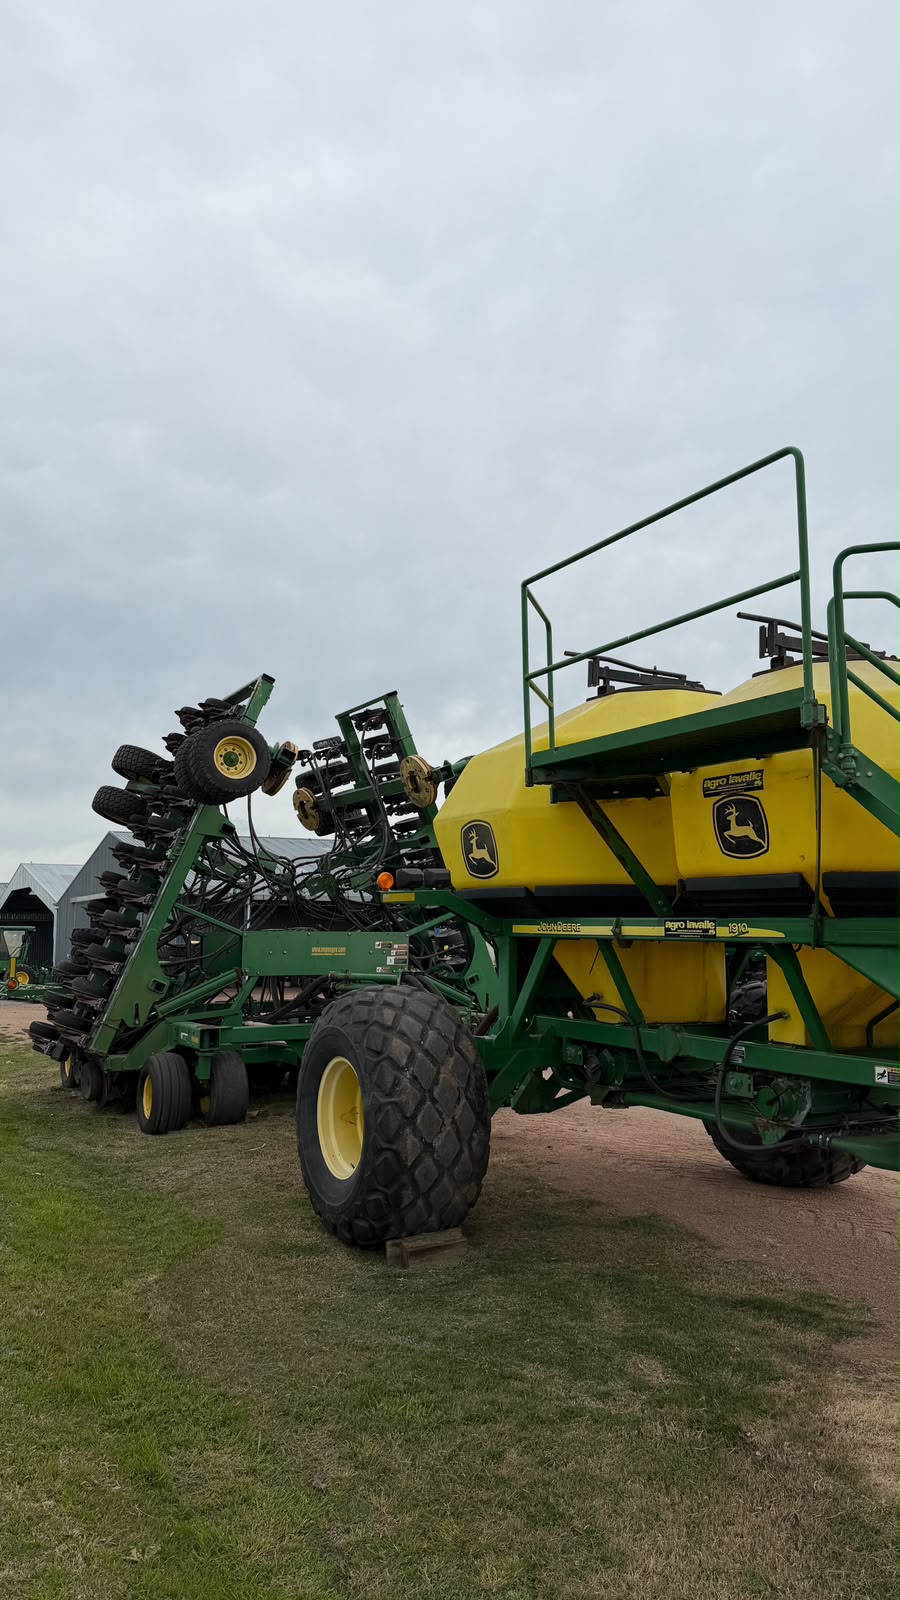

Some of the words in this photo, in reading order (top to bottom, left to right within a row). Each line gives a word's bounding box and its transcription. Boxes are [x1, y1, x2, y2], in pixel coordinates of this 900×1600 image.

[704, 777, 727, 789] agro
[729, 771, 762, 784] lavalle
[665, 921, 685, 931] agro
[686, 920, 715, 929] lavalle
[728, 922, 748, 935] 1910
